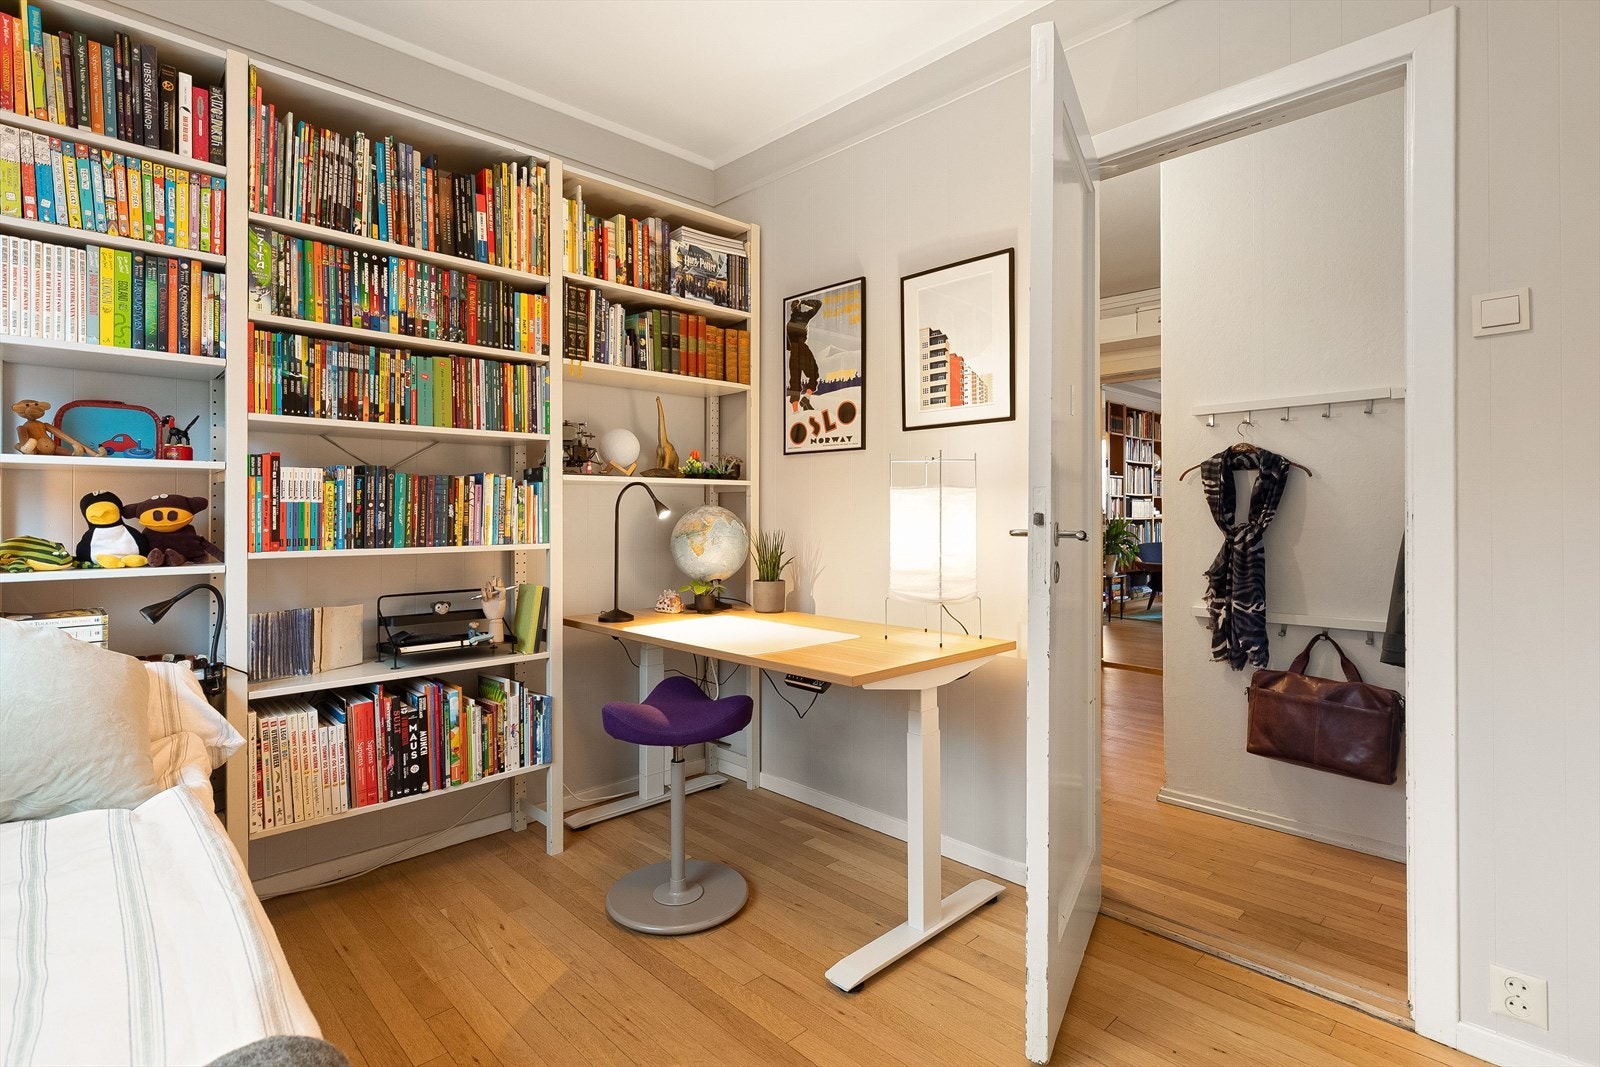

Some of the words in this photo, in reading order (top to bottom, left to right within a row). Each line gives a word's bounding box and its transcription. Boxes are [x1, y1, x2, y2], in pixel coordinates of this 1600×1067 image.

[32, 9, 40, 27] Roald
[33, 29, 41, 45] Dahl
[143, 62, 153, 101] UBESVART
[144, 102, 153, 130] ANROP
[256, 237, 266, 269] ZITA
[684, 254, 700, 268] Harry
[699, 257, 718, 274] Potter
[117, 280, 129, 302] EGOLAND
[789, 400, 857, 446] OSLO
[810, 435, 853, 445] NORWAY
[393, 710, 401, 734] SULT
[271, 729, 279, 754] UTROLIGE
[366, 739, 375, 764] Sapiens
[408, 723, 418, 759] MAUS
[419, 730, 428, 756] MUNCH
[272, 754, 280, 769] IDEER
[356, 741, 364, 767] Sapiens
